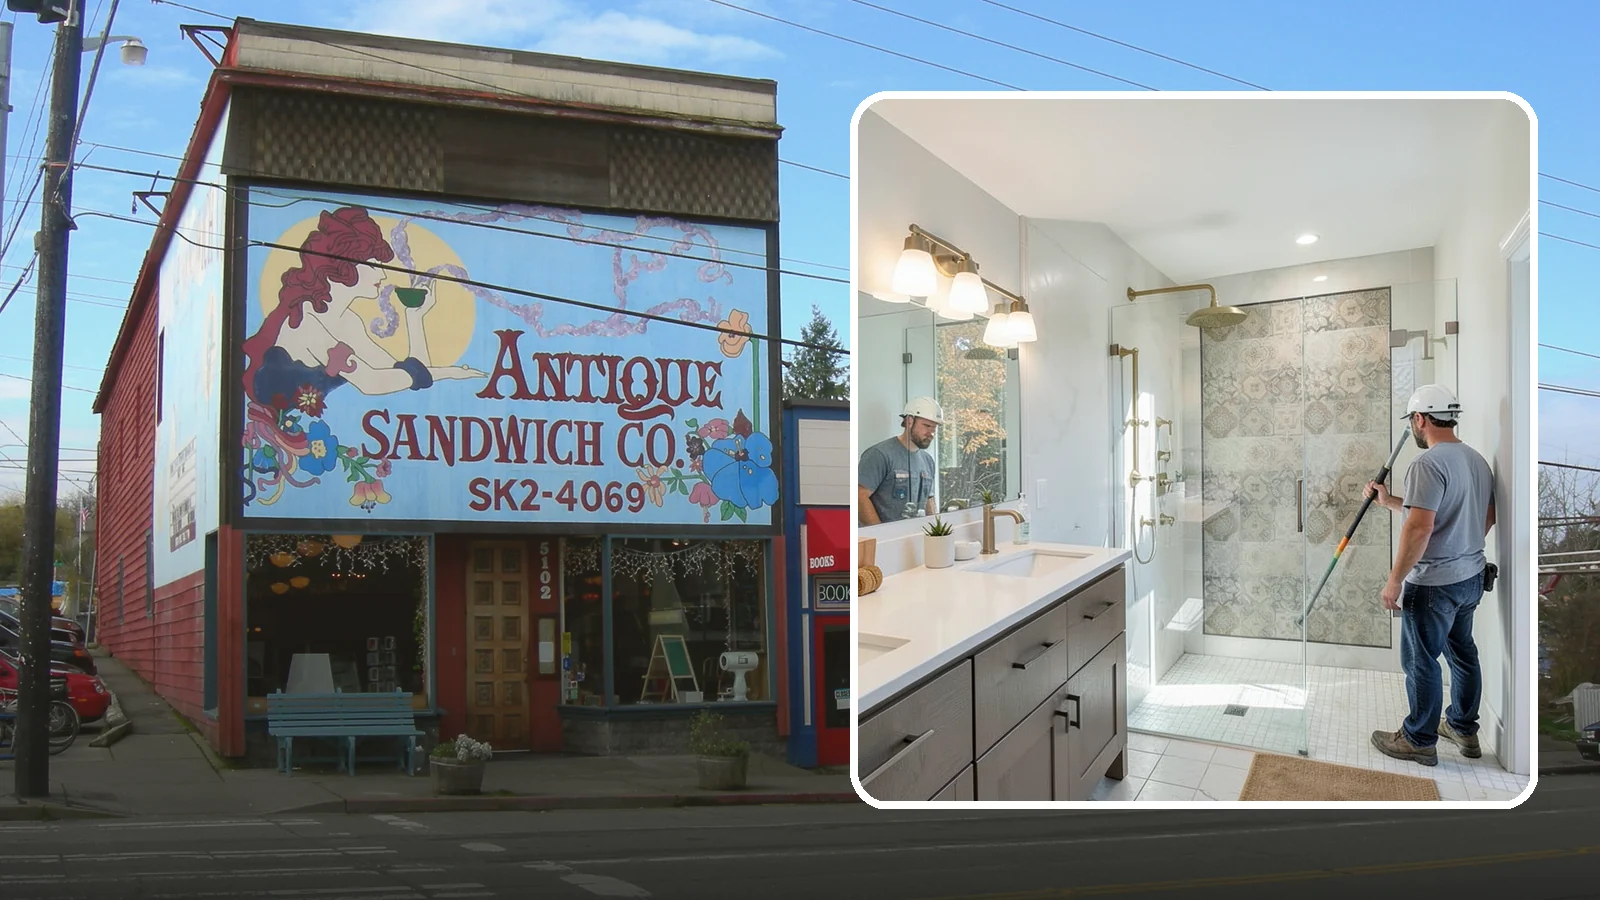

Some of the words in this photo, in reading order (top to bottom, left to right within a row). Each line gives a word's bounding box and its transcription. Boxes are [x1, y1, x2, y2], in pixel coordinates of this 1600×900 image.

[476, 328, 723, 421] ANTIQUE
[361, 408, 605, 467] SANDWICH
[617, 421, 685, 469] CO.
[468, 477, 647, 513] SK2-4069
[540, 542, 552, 599] 5102
[809, 555, 835, 569] BOOKS
